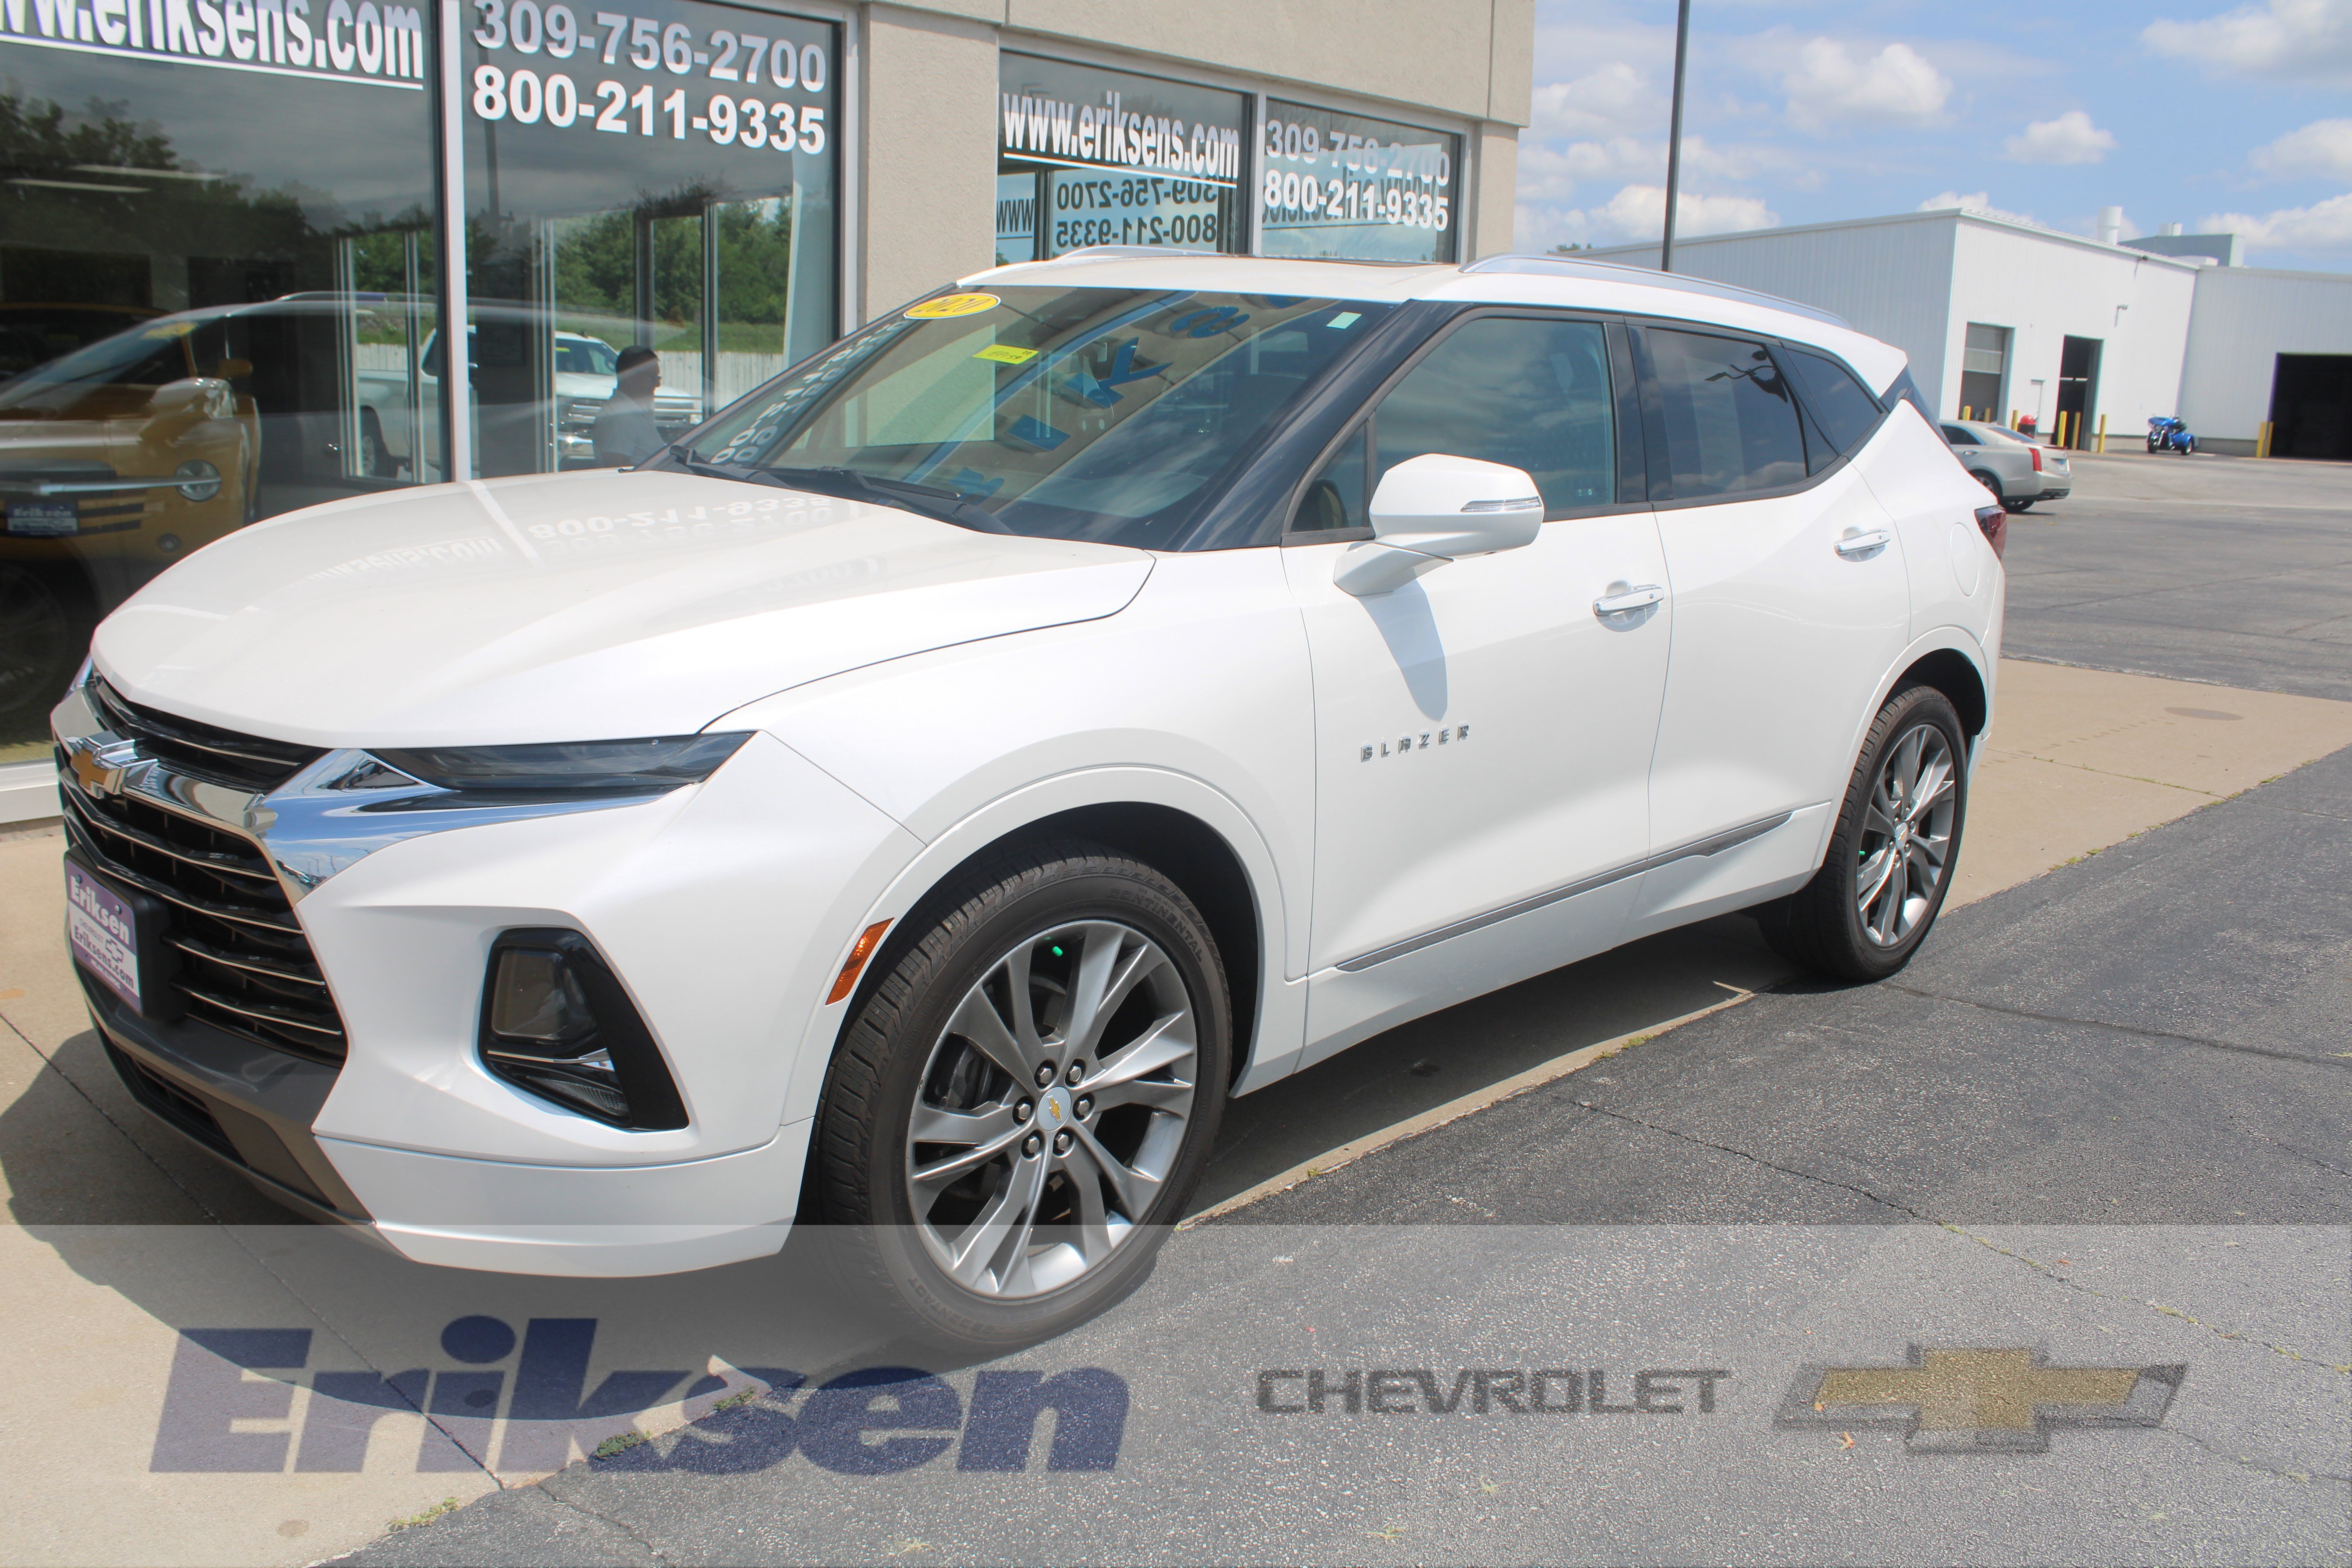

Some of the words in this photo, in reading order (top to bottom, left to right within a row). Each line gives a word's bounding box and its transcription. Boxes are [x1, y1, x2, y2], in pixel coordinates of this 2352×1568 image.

[474, 0, 826, 93] 309-756-2700
[473, 65, 825, 154] 800-211-9335
[1003, 90, 1239, 179] www.eriksens.com
[1266, 119, 1450, 187] 309-756-2700
[1265, 169, 1448, 232] 800-211-9335
[1360, 724, 1469, 762] BLAZER
[70, 875, 130, 945] Eriksen
[1106, 888, 1203, 962] CONTINENTAL
[74, 924, 134, 989] Eriksens.com
